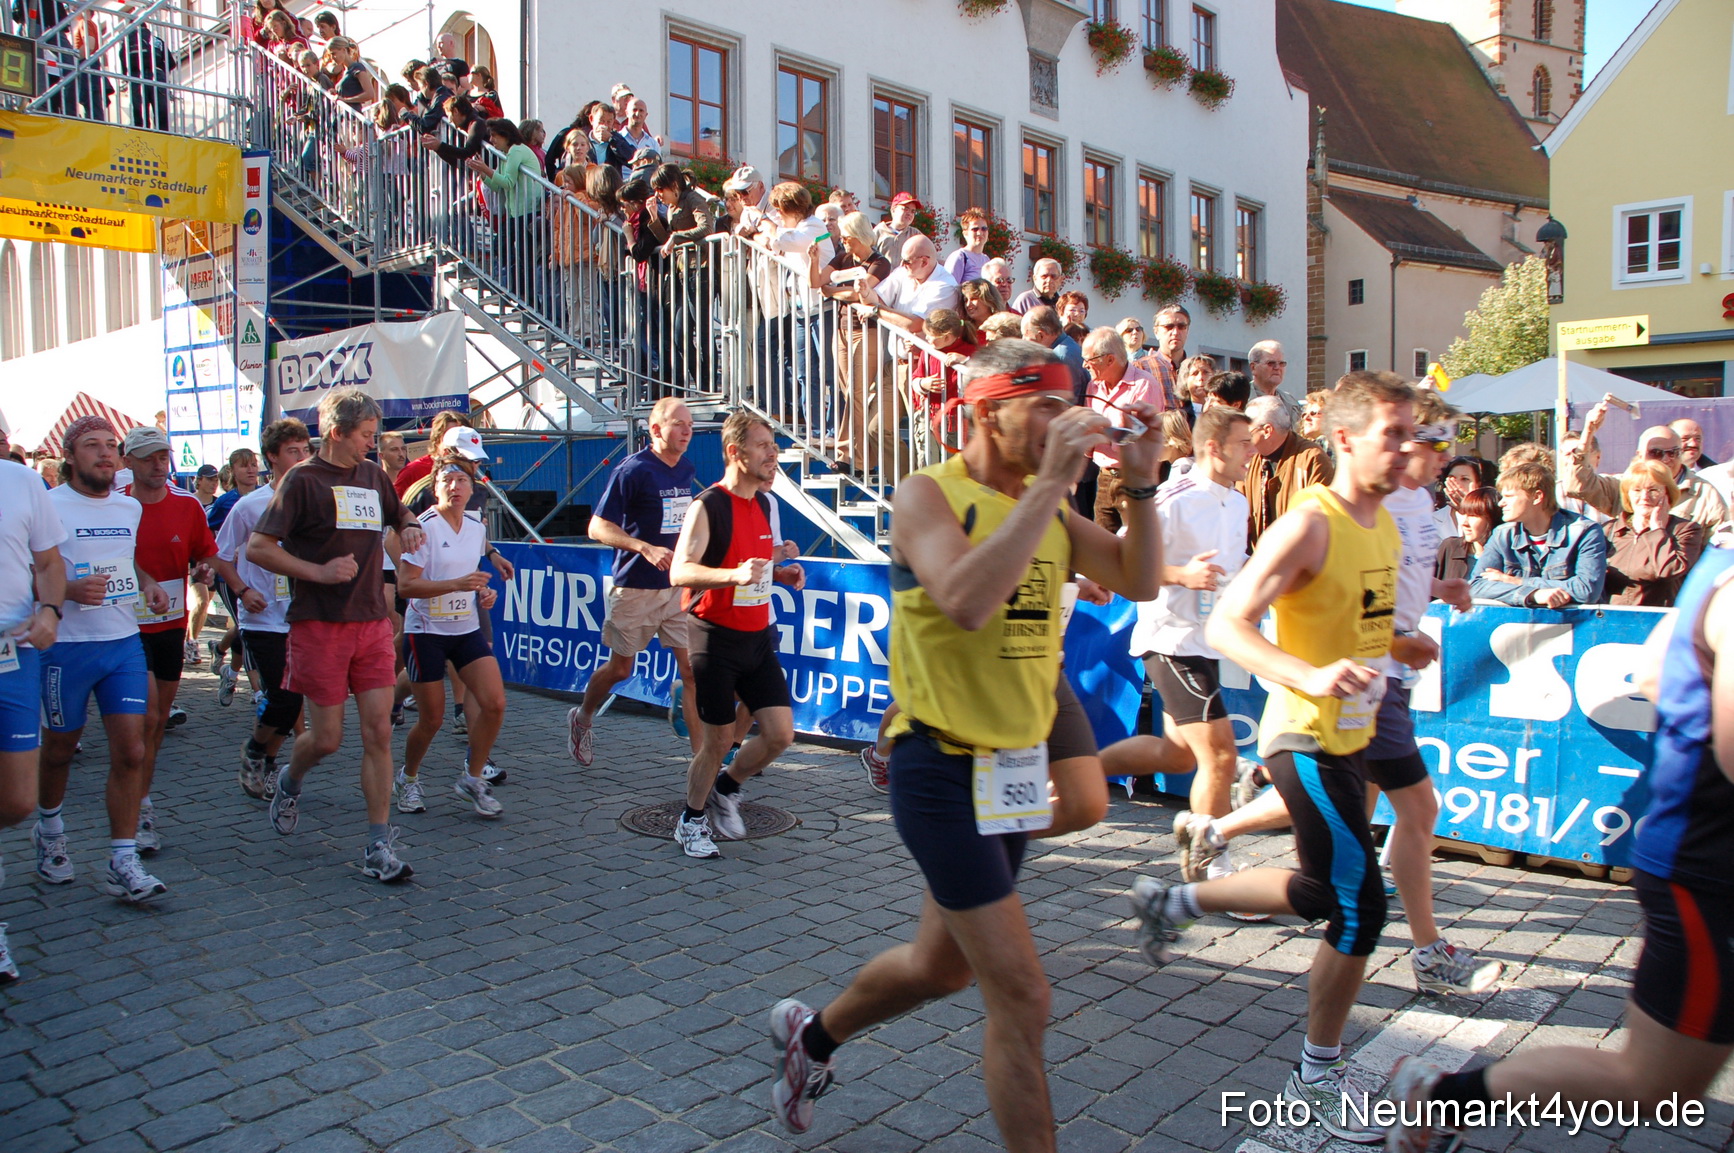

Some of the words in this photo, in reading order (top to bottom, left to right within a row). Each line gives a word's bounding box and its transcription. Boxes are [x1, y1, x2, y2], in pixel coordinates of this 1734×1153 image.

[65, 167, 147, 187] Neumarkter
[150, 178, 208, 195] Stadtlauf
[73, 213, 126, 228] Stadtlauf
[1575, 335, 1616, 346] ausgabe
[354, 505, 376, 517] 518
[93, 565, 118, 575] Marco
[448, 598, 467, 610] 129
[1433, 786, 1648, 847] 9181/9
